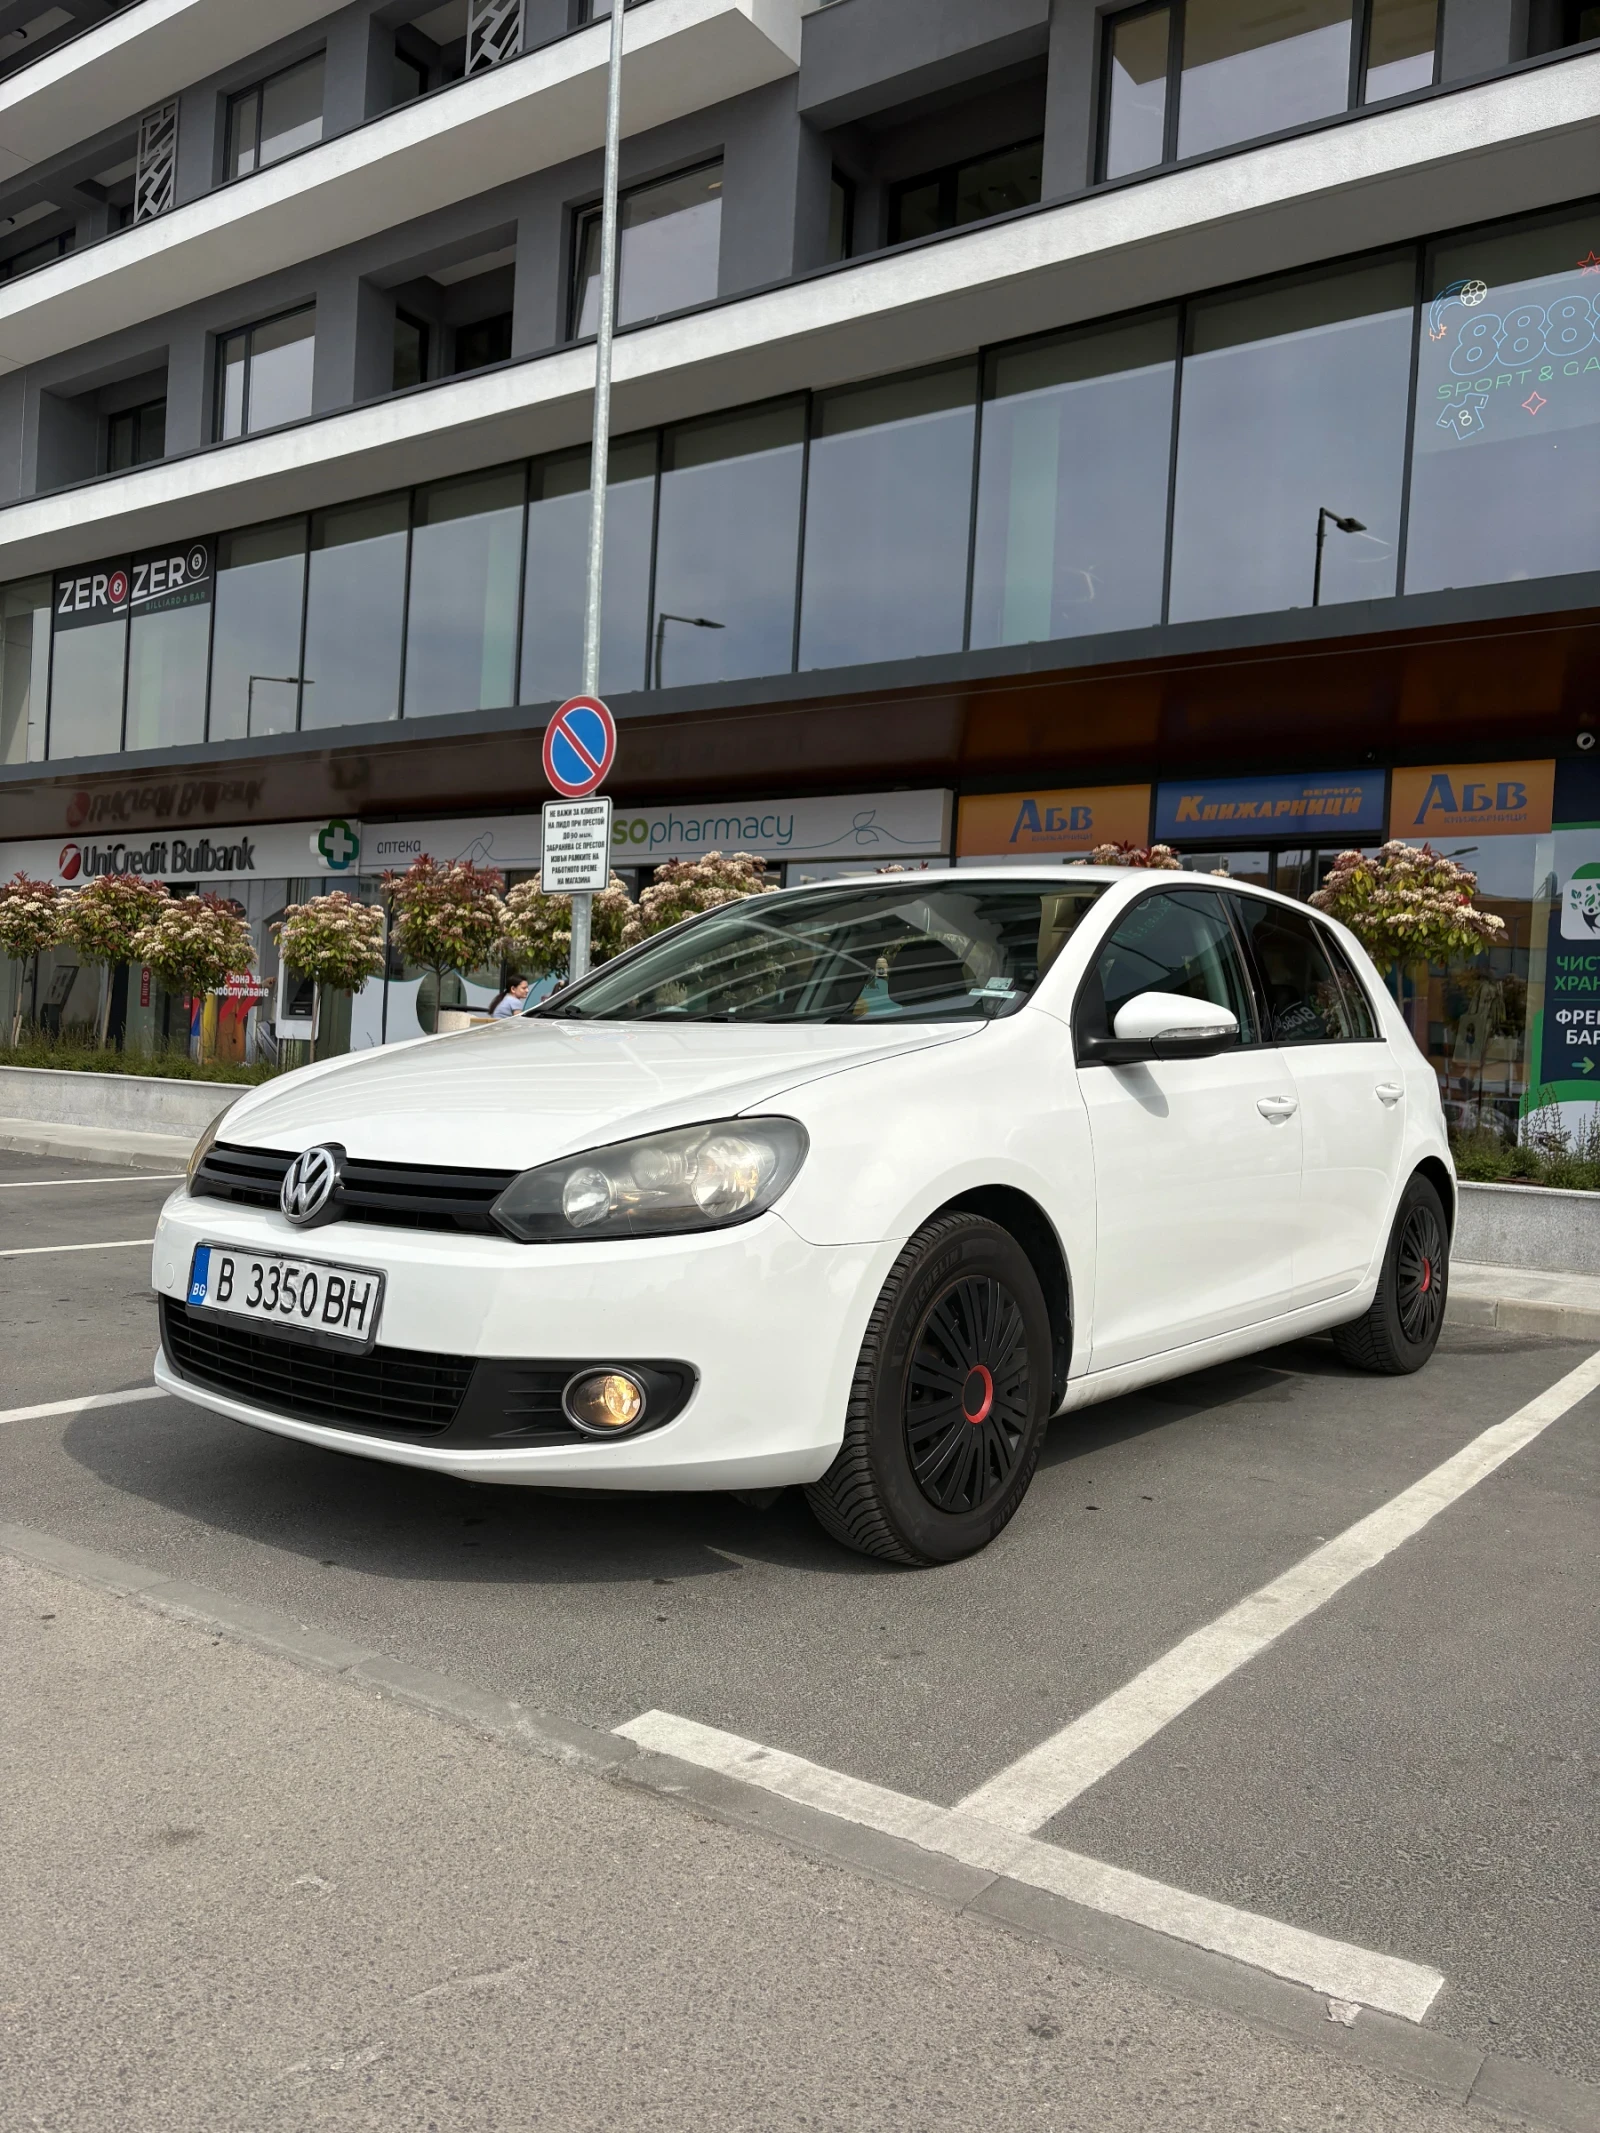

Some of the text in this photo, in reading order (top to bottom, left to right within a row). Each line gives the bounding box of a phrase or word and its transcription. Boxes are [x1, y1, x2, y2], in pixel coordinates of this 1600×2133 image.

[1449, 291, 1600, 376] 888
[1436, 369, 1532, 400] SPORT
[1538, 366, 1554, 382] &
[145, 596, 181, 611] BILLIARD
[189, 591, 206, 602] BAR
[1302, 786, 1363, 798] ВЕРИГА
[1412, 773, 1528, 825] АБВ
[549, 806, 604, 818] НЕ ВАЖИ ЗА КЛИЕНТИ
[1443, 812, 1528, 824] КНИЖАРНИЦИ
[548, 821, 555, 829] НА
[571, 819, 582, 827] ПРИ
[582, 816, 605, 826] ПРЕСТОЙ
[1009, 798, 1094, 843] АБВ
[562, 832, 570, 840] ДО
[612, 812, 794, 851] sopharmacy
[376, 840, 421, 854] аптека
[546, 843, 574, 852] ЗАБРАНЯВА
[575, 842, 582, 850] СЕ
[83, 836, 256, 877] UniCredit Bulbank
[550, 852, 600, 863] ИЗВЪН РАМКИТЕ НА
[551, 864, 598, 874] РАБОТНОТО ВРЕМЕ
[557, 876, 591, 885] НА МАГАЗИНА
[229, 974, 262, 984] Зона за
[1555, 1008, 1600, 1025] ФРЕ
[192, 1283, 206, 1297] BG
[245, 1262, 319, 1318] 3350
